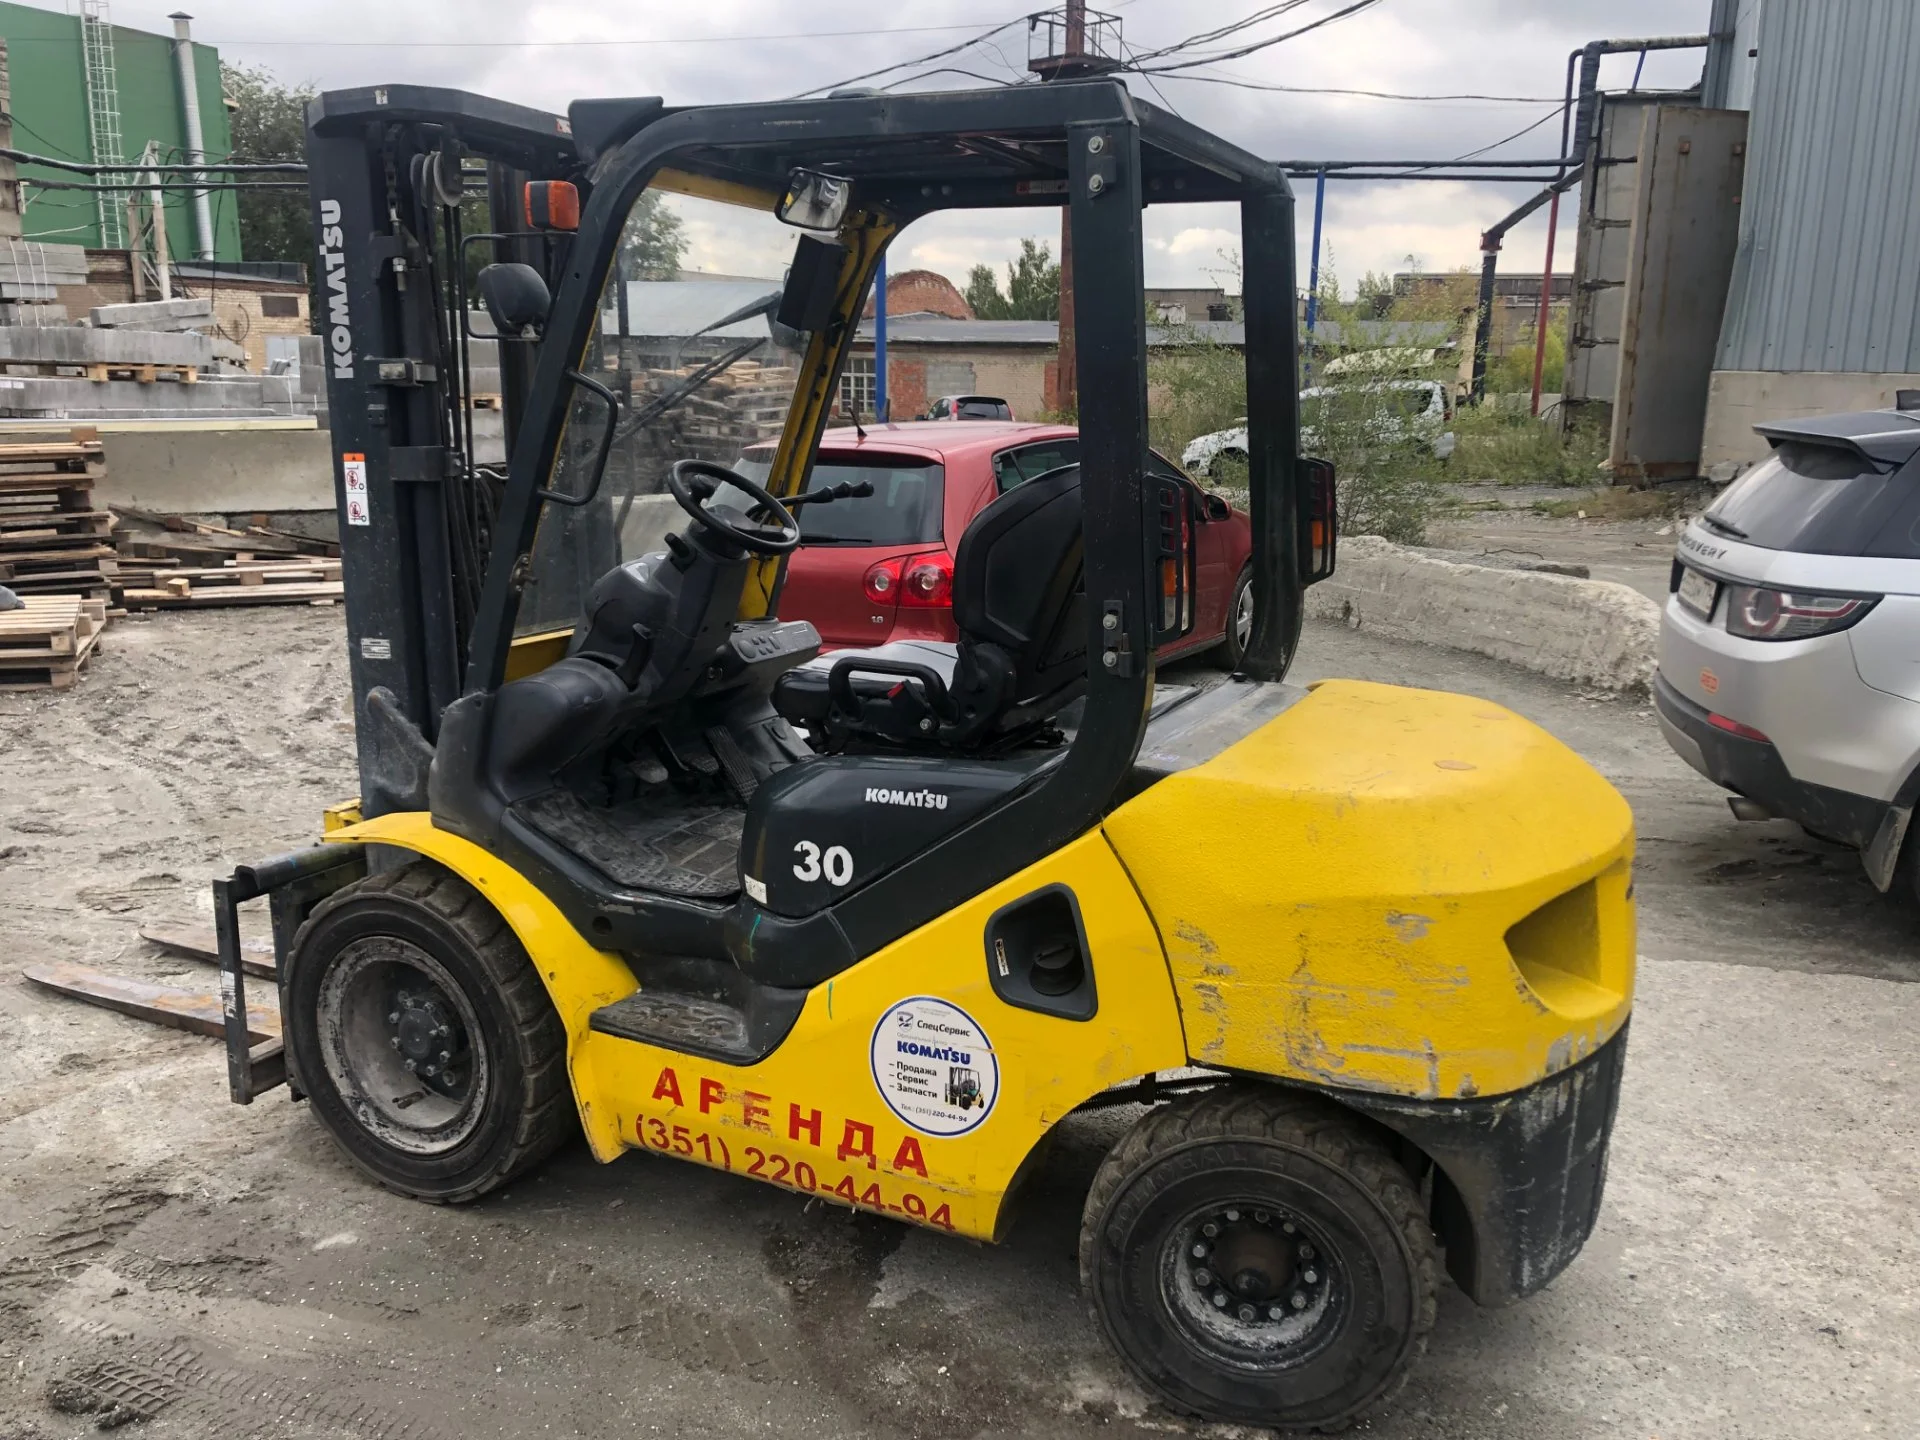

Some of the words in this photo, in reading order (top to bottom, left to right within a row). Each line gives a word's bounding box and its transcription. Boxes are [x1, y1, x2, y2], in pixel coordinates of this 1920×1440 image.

[319, 199, 354, 379] KOMATSU
[865, 788, 948, 810] KOMATSU
[793, 840, 854, 887] 30
[917, 1019, 971, 1037] СпецСервис
[897, 1040, 971, 1065] KOMATSU
[896, 1061, 937, 1077] Продажа
[896, 1072, 929, 1086] Сервис
[896, 1083, 938, 1099] Запчасти
[651, 1067, 929, 1179] АРЕНДА
[932, 1110, 968, 1123] 220-44-94
[635, 1113, 731, 1171] (351)
[744, 1146, 956, 1232] 220-44-94
